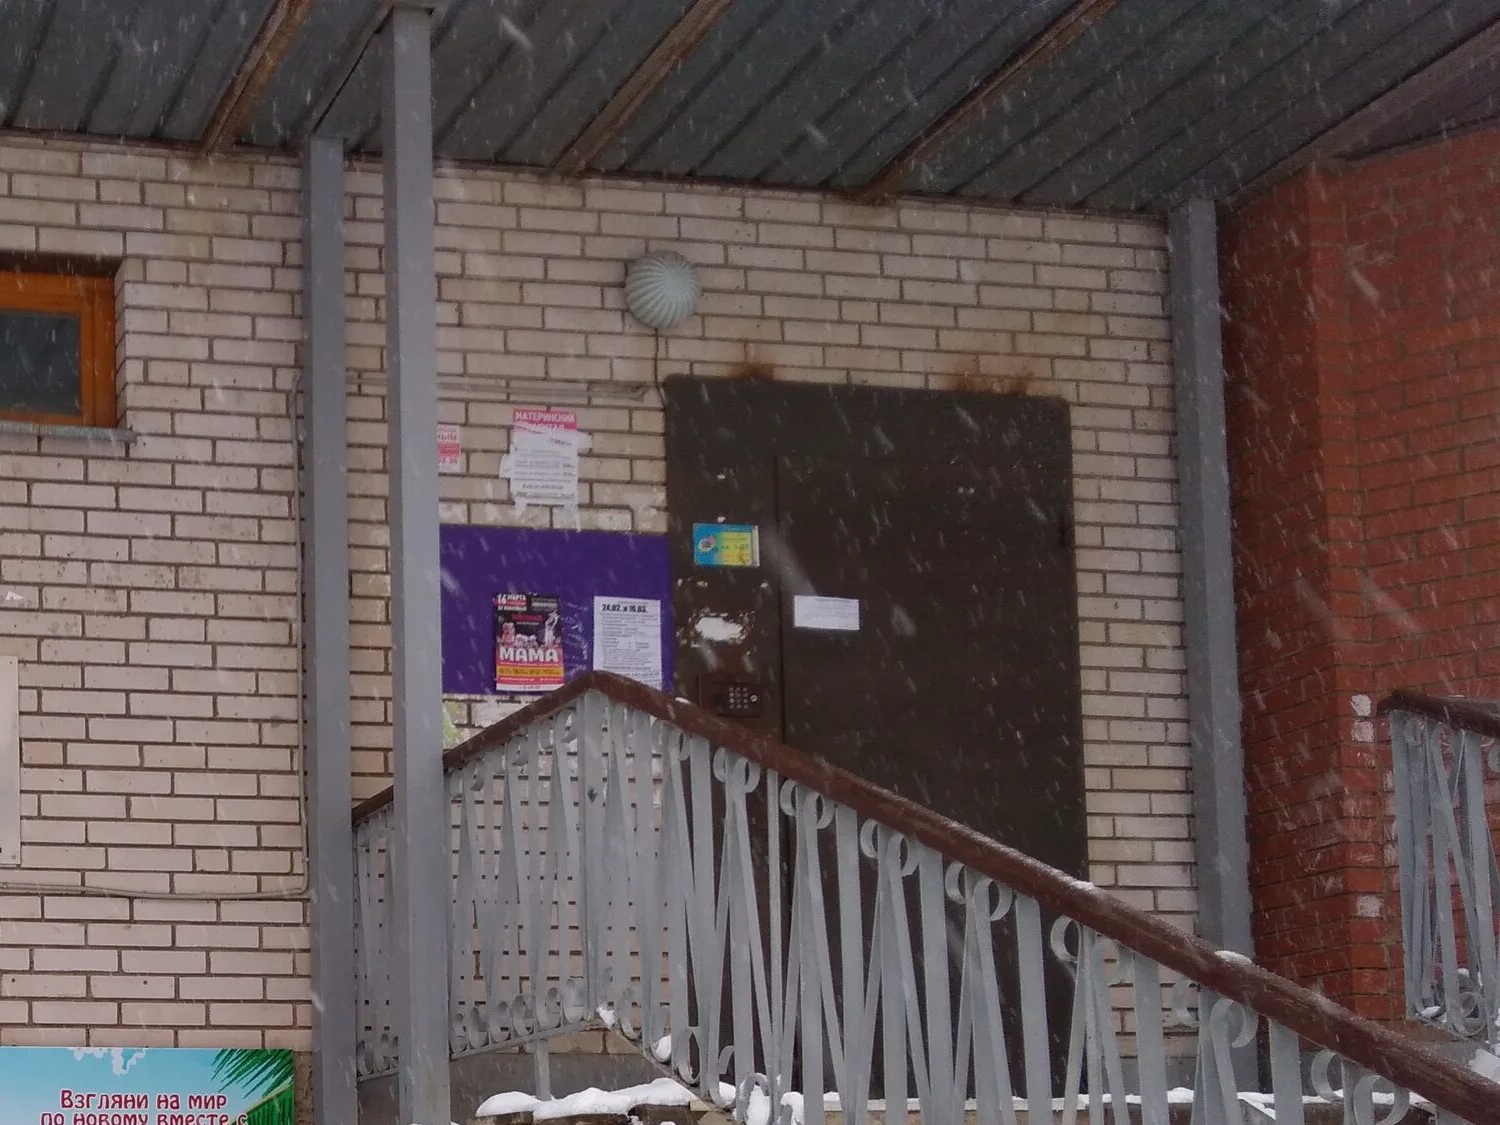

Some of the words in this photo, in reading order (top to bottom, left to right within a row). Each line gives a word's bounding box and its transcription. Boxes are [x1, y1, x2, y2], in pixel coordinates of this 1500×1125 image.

[514, 410, 576, 423] МАТЕРИНСКИЙ
[499, 647, 559, 662] МАМА
[60, 1089, 149, 1111] Взгляни
[156, 1093, 181, 1110] на
[188, 1093, 227, 1111] мир
